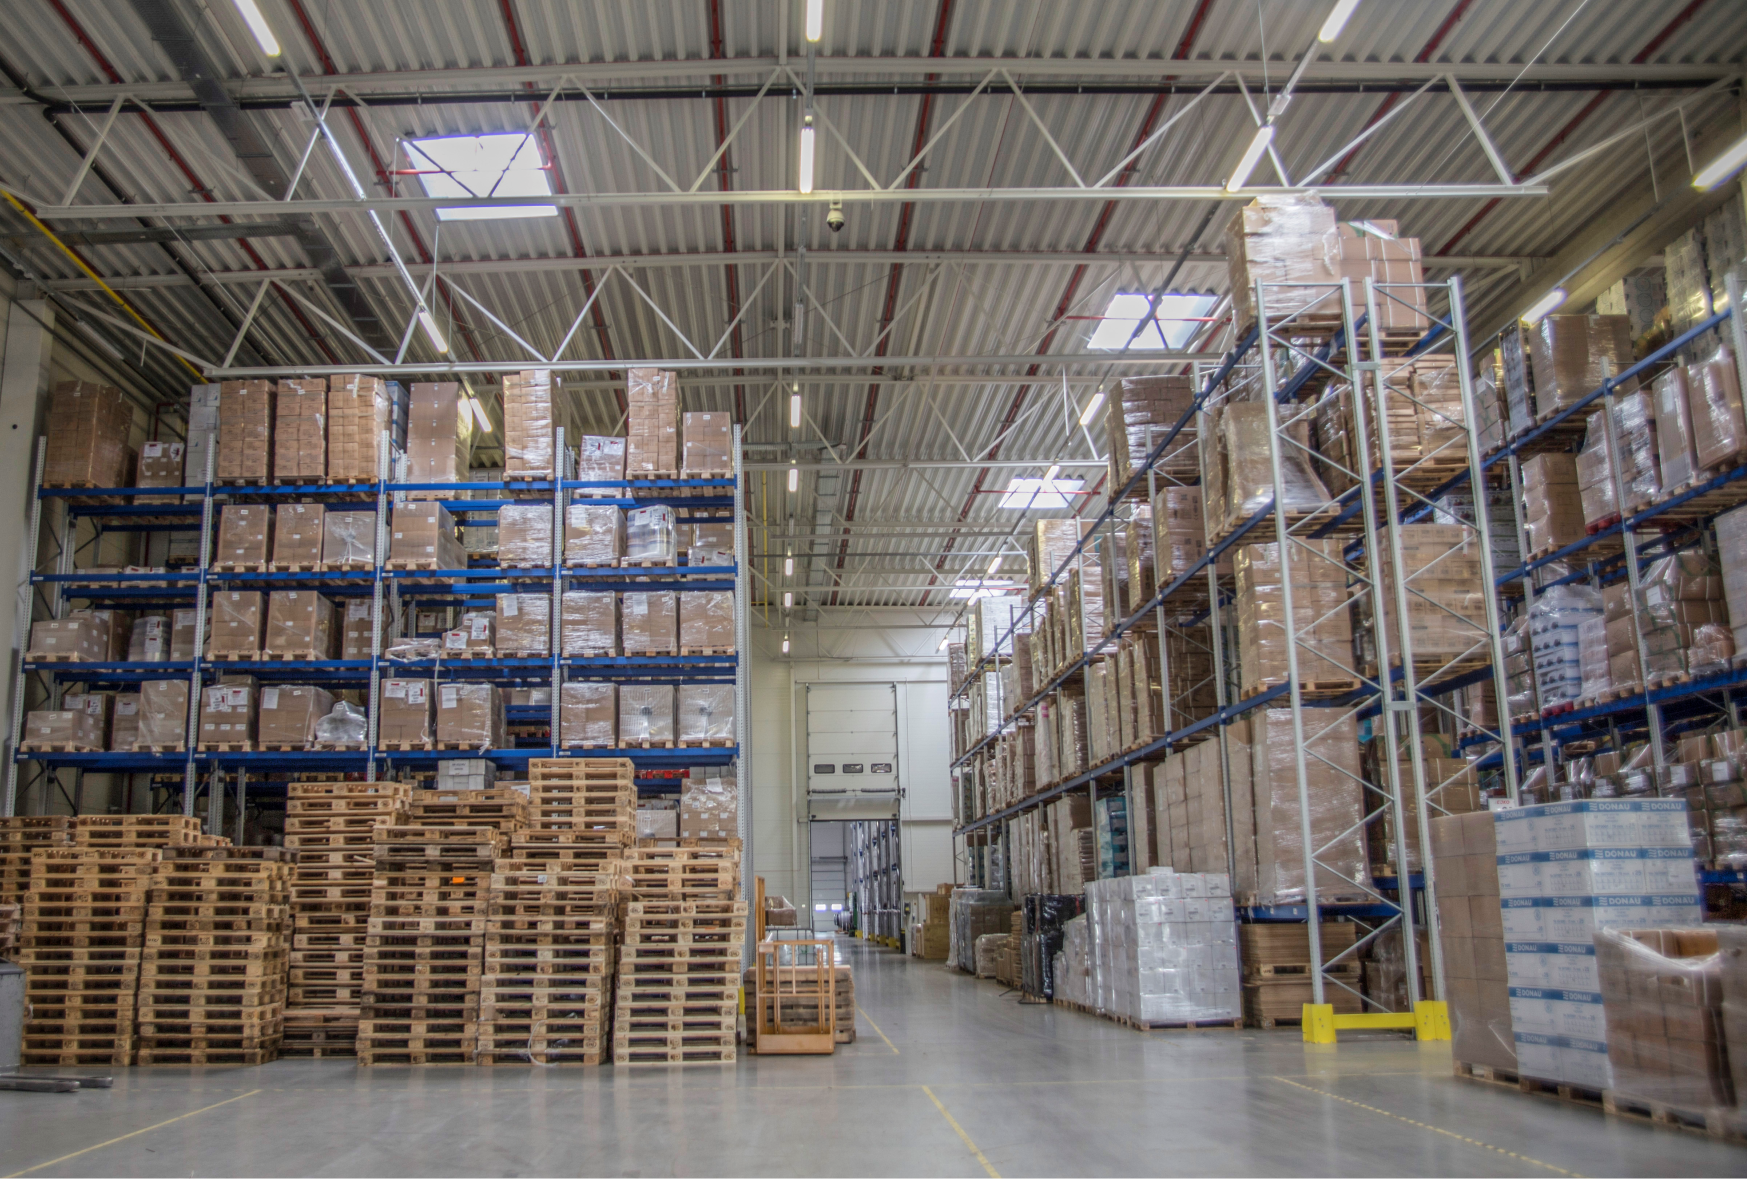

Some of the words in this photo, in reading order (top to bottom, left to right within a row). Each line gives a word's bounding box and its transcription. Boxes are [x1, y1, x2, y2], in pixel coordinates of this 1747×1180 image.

[1551, 804, 1571, 814] DONAU
[1599, 802, 1630, 811] DONAU
[1651, 802, 1682, 810] DONAU
[1604, 850, 1637, 858] DONAU
[1657, 849, 1689, 857] DONAU
[1511, 855, 1530, 864] DONAU
[1513, 898, 1532, 907] DONAU
[1558, 897, 1581, 905] DONAU
[1609, 897, 1641, 905] DONAU
[1662, 896, 1695, 904] DONAU
[1564, 946, 1586, 954] DONAU
[1521, 989, 1542, 997] DONAU
[1569, 992, 1592, 1001] DONAU
